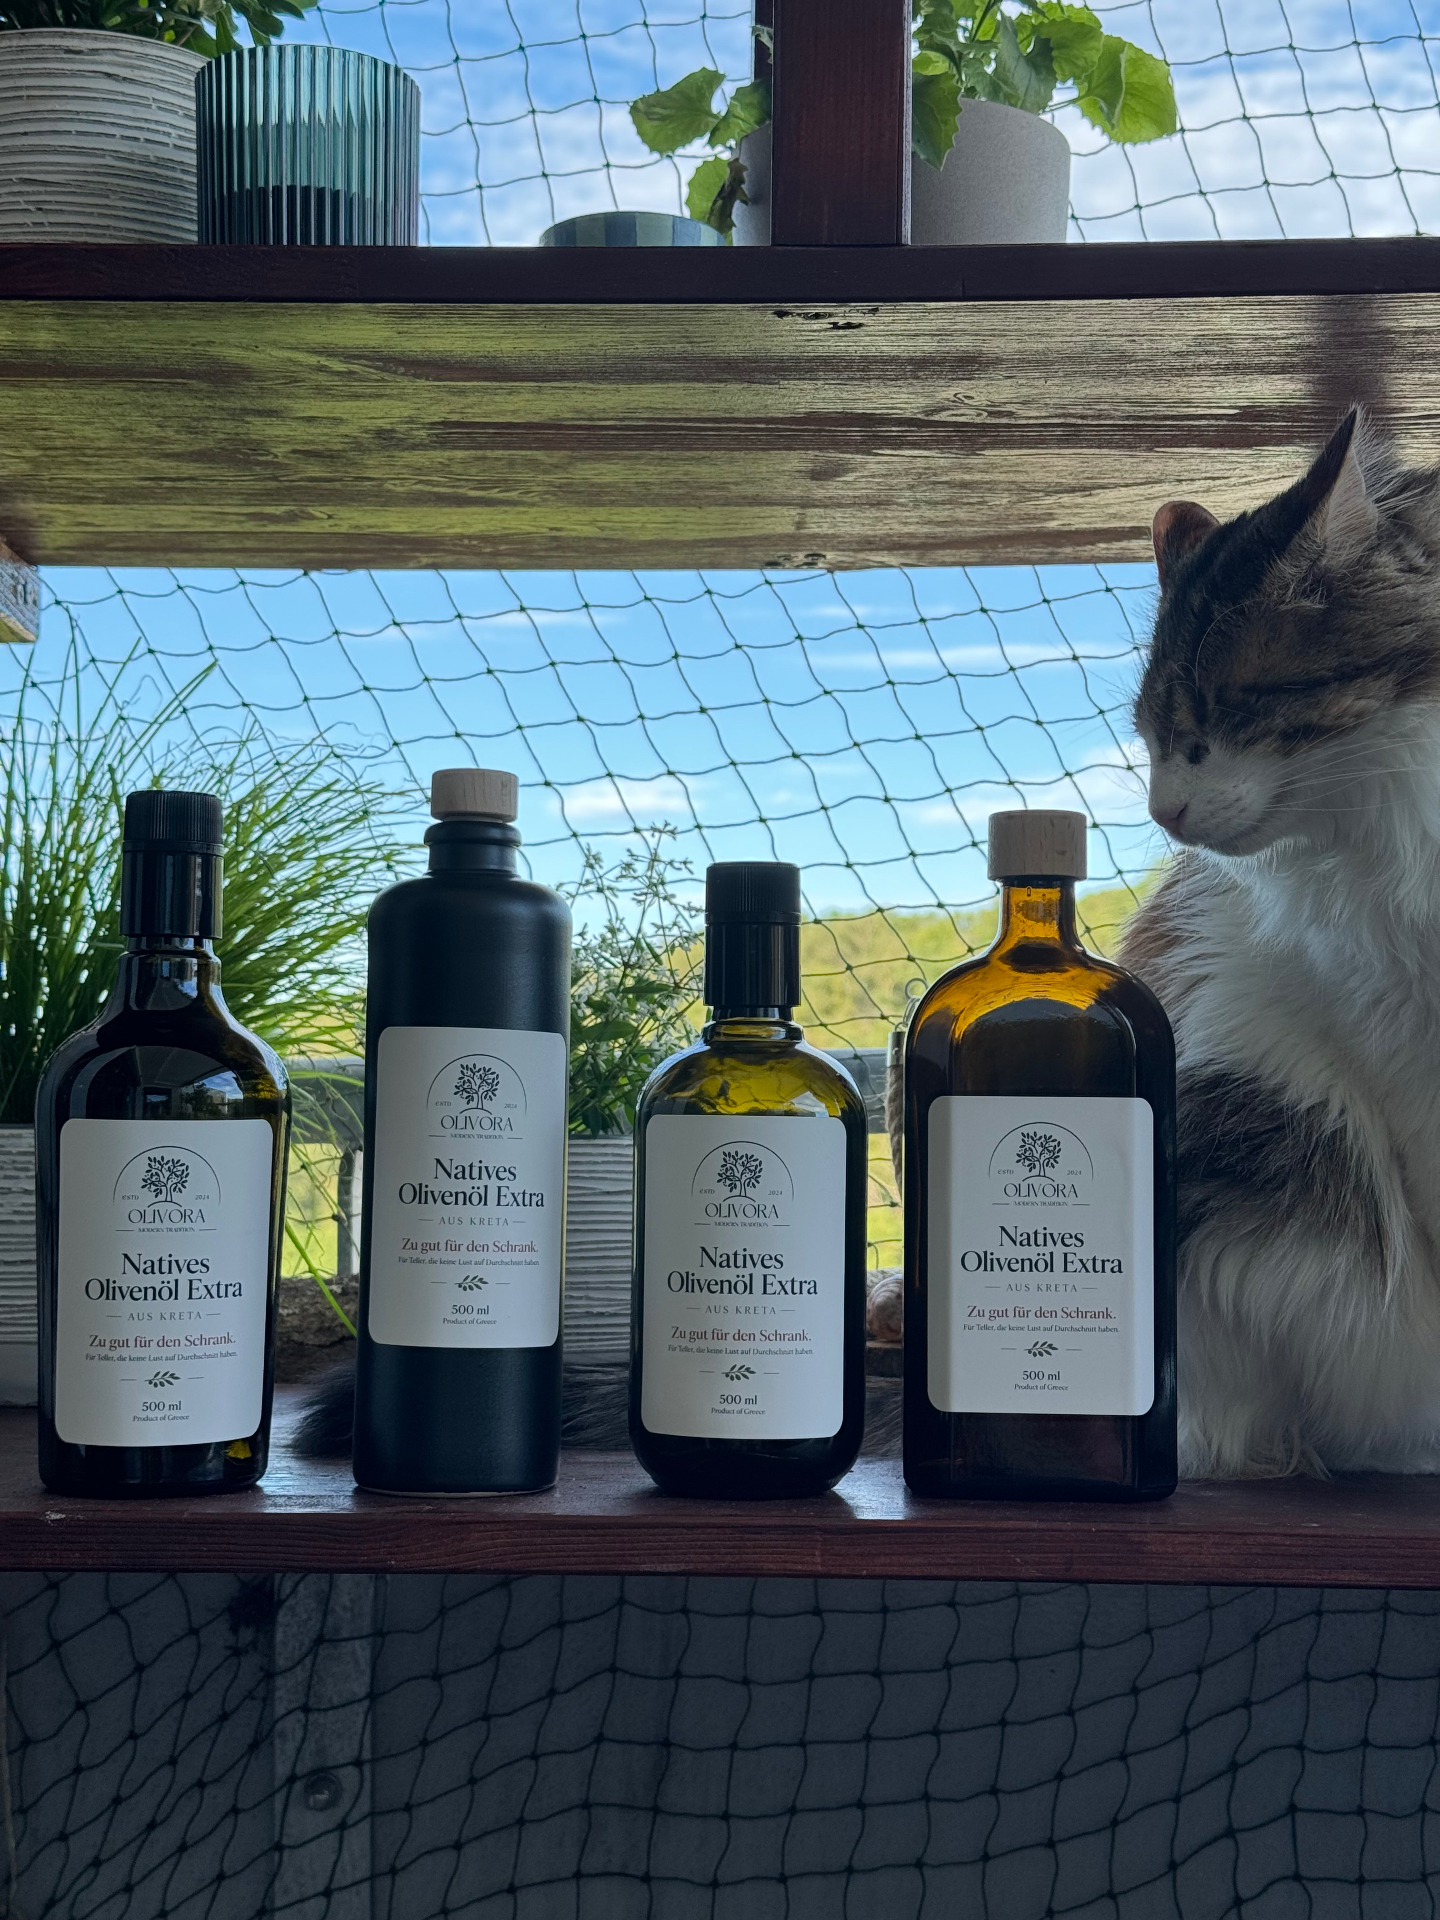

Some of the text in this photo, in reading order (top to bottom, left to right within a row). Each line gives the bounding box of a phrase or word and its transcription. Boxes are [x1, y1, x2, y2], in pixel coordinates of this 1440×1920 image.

[441, 1115, 513, 1131] OLIVORA
[434, 1158, 517, 1181] Natives
[399, 1182, 544, 1207] Olivenöl Extra
[1004, 1183, 1078, 1198] OLIVORA
[128, 1209, 206, 1224] OLIVORA
[705, 1203, 778, 1218] OLIVORA
[439, 1217, 509, 1227] AUS KRETA
[999, 1225, 1084, 1247] Natives
[402, 1238, 538, 1254] Zu gut für den Schrank.
[122, 1253, 210, 1275] Natives
[440, 1258, 457, 1266] keine
[700, 1246, 783, 1269] Natives
[961, 1250, 1123, 1273] Olivenöl Extra
[85, 1278, 242, 1301] Olivenöl Extra
[668, 1271, 818, 1295] Olivenöl Extra
[1006, 1284, 1078, 1293] AUS KRETA
[128, 1312, 203, 1322] AUS KRETA
[452, 1305, 489, 1315] 500 ml
[705, 1305, 777, 1315] AUS KRETA
[967, 1306, 1116, 1321] Zu gut für den Schrank.
[672, 1326, 811, 1342] Zu gut für den Schrank.
[1009, 1324, 1026, 1332] keine
[1043, 1325, 1054, 1333] auf
[1055, 1325, 1097, 1333] Durchschnitt
[89, 1332, 236, 1350] Zu gut für den Schrank.
[86, 1353, 96, 1362] Für
[117, 1354, 128, 1362] die
[129, 1353, 147, 1362] keine
[149, 1354, 164, 1362] Lust
[165, 1354, 177, 1362] auf
[177, 1352, 219, 1362] Durchschnitt
[707, 1347, 724, 1355] keine
[725, 1348, 740, 1356] Lust
[741, 1348, 752, 1356] auf
[753, 1348, 794, 1356] Durchschnitt
[1022, 1371, 1060, 1381] 500 ml
[142, 1401, 182, 1411] 500 ml
[719, 1394, 758, 1406] 500 ml
